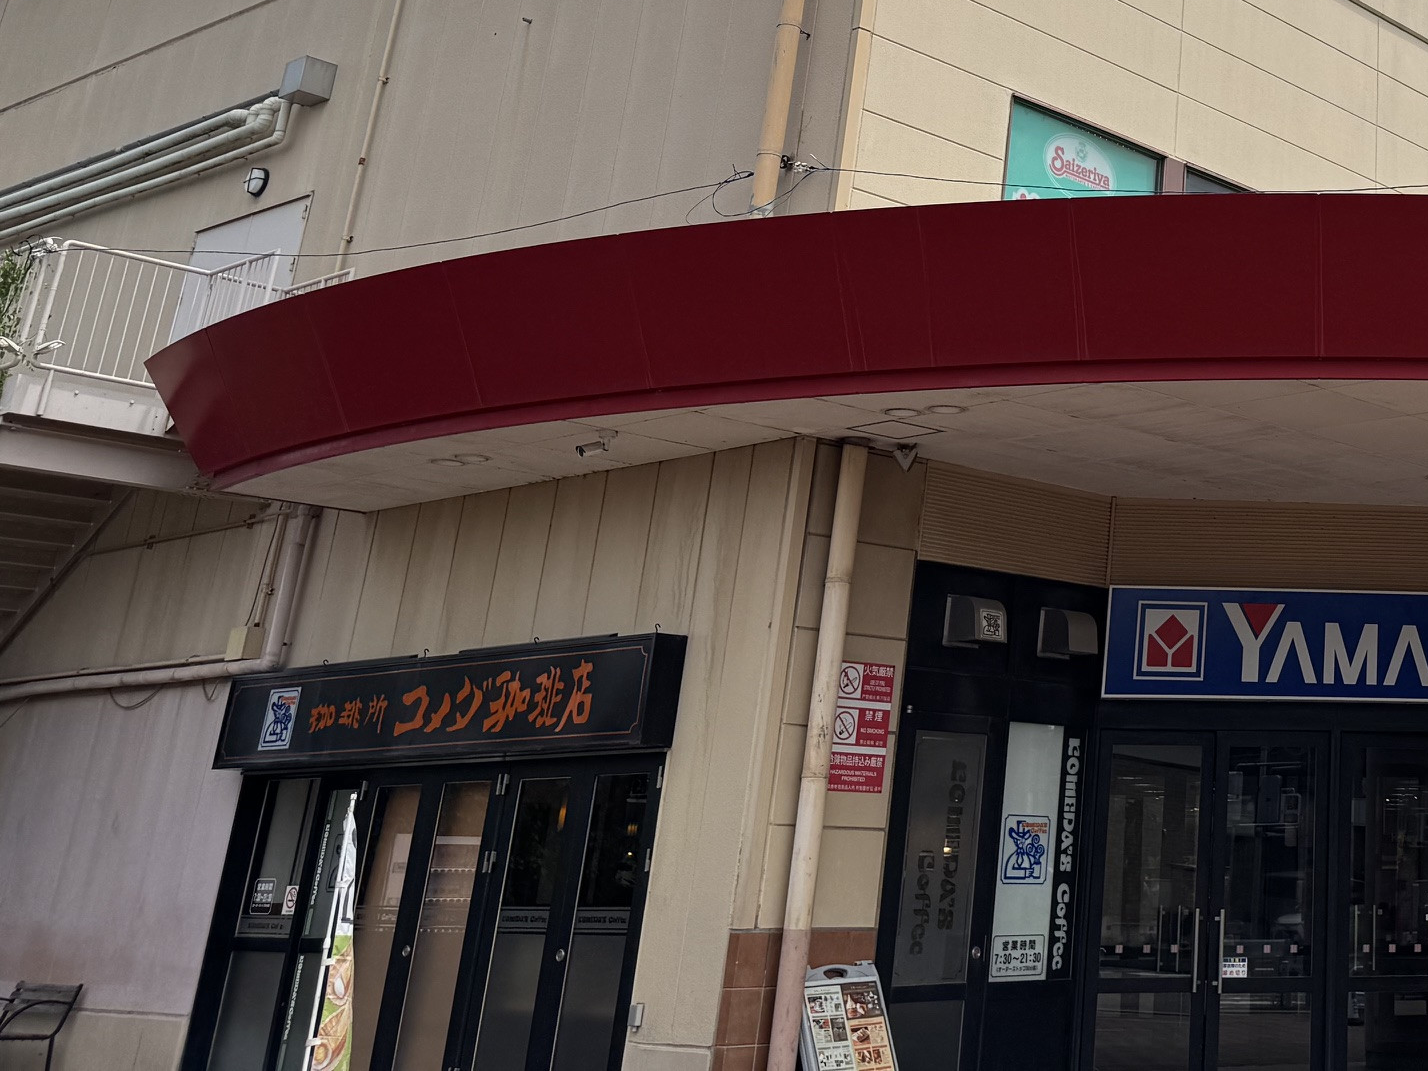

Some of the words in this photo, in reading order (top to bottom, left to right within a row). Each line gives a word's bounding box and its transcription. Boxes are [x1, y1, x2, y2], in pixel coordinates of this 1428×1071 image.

[1049, 145, 1110, 190] Saizeriya
[864, 665, 894, 678] 火気厳禁
[308, 693, 388, 734] 珈琲所
[864, 710, 883, 722] 禁煙
[1002, 939, 1036, 951] 営業時間
